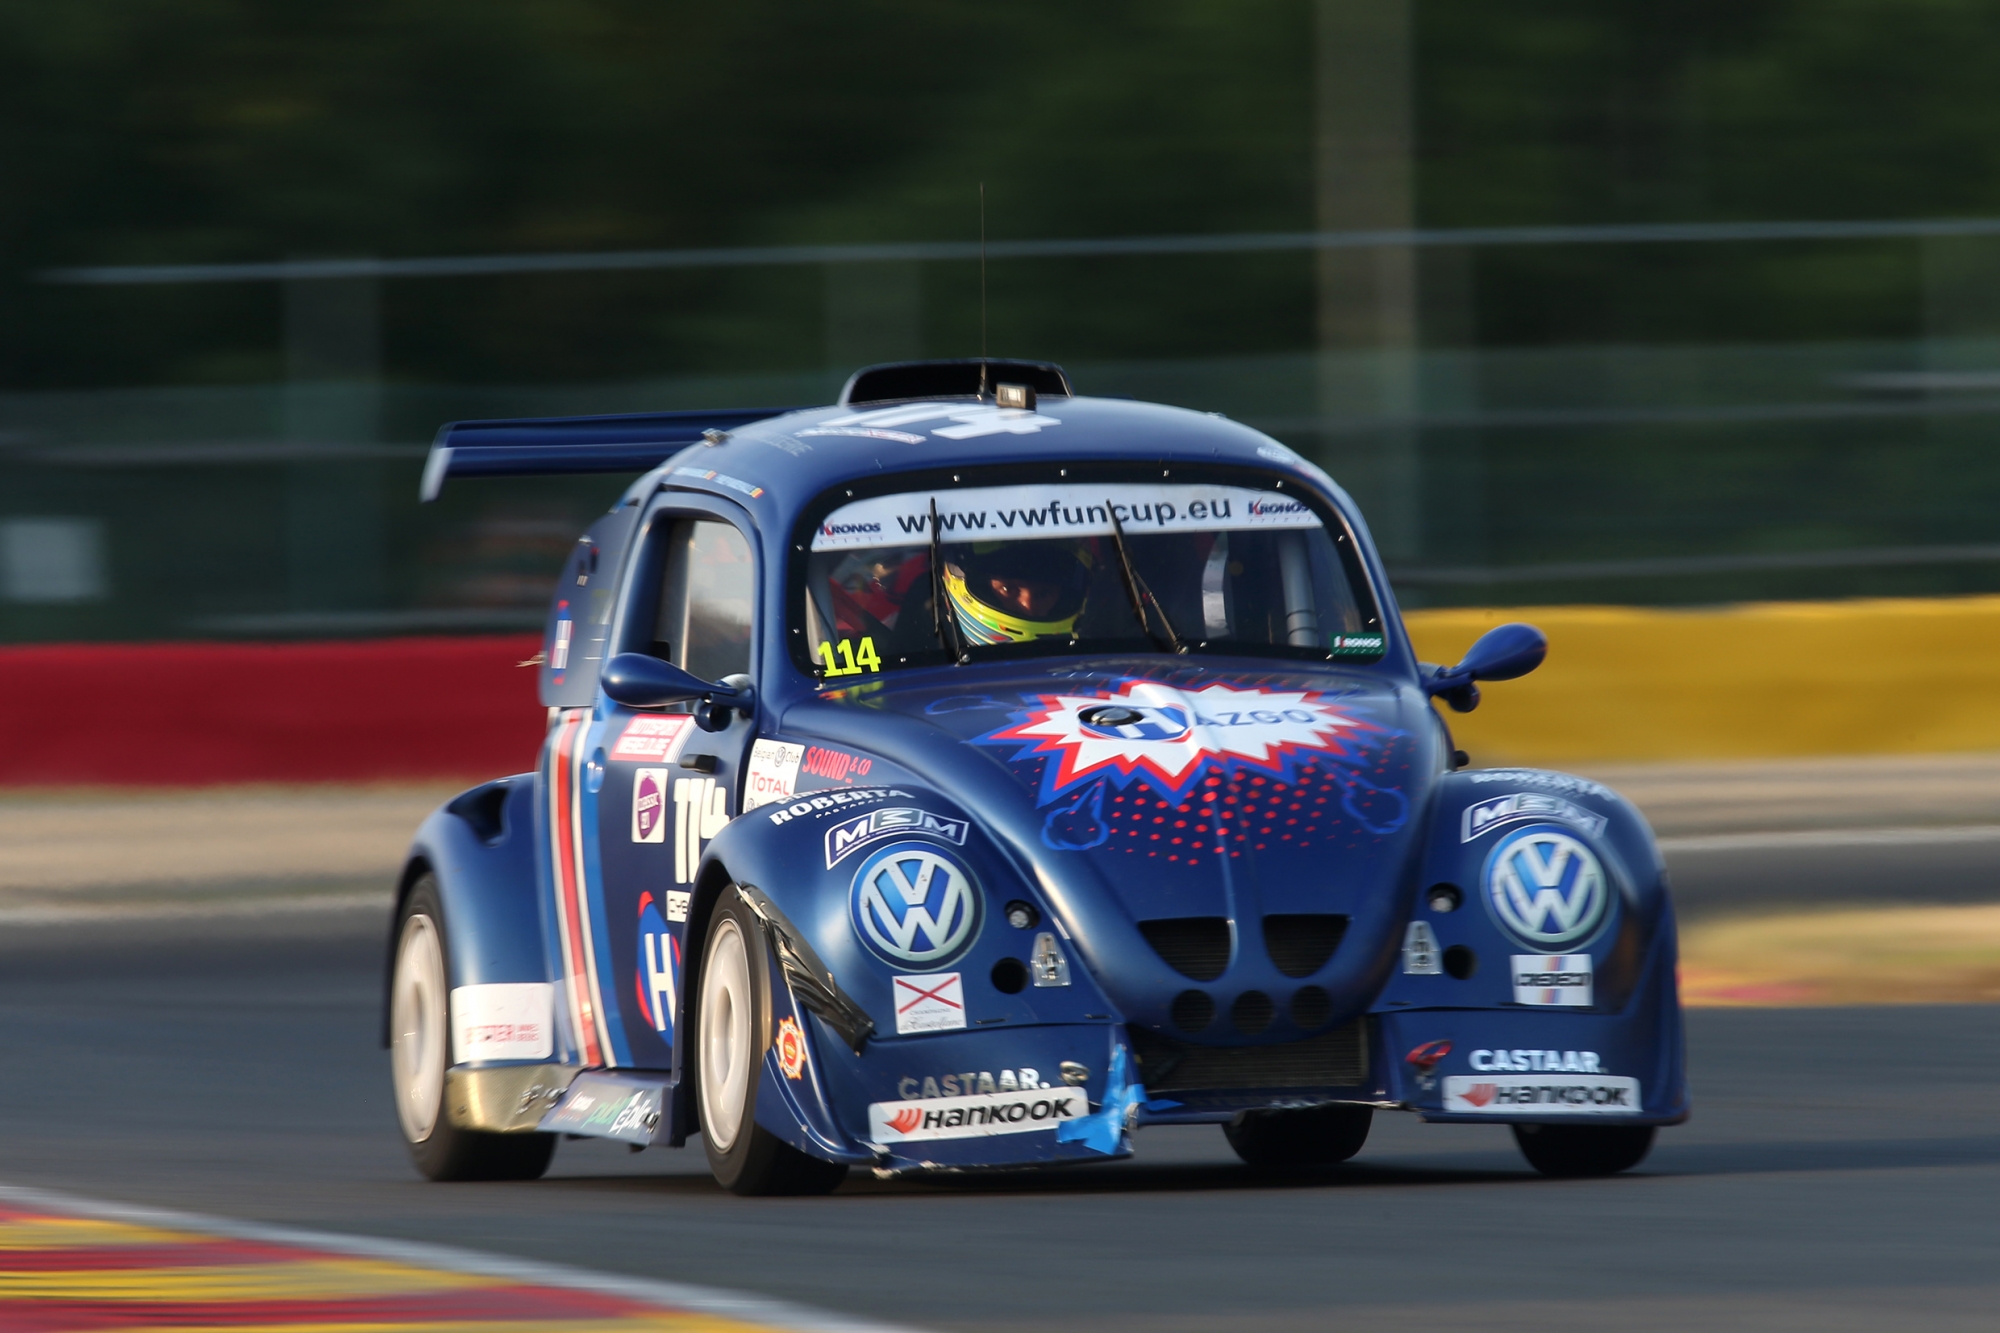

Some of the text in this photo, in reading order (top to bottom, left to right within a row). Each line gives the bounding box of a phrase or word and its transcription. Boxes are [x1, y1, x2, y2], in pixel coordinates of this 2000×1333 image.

[818, 520, 882, 536] KRONOS
[896, 498, 1232, 534] www.vwfuncup.eu
[817, 636, 881, 677] 114
[802, 746, 852, 781] SOUND
[857, 758, 873, 776] CO
[769, 789, 916, 826] ROBERTA
